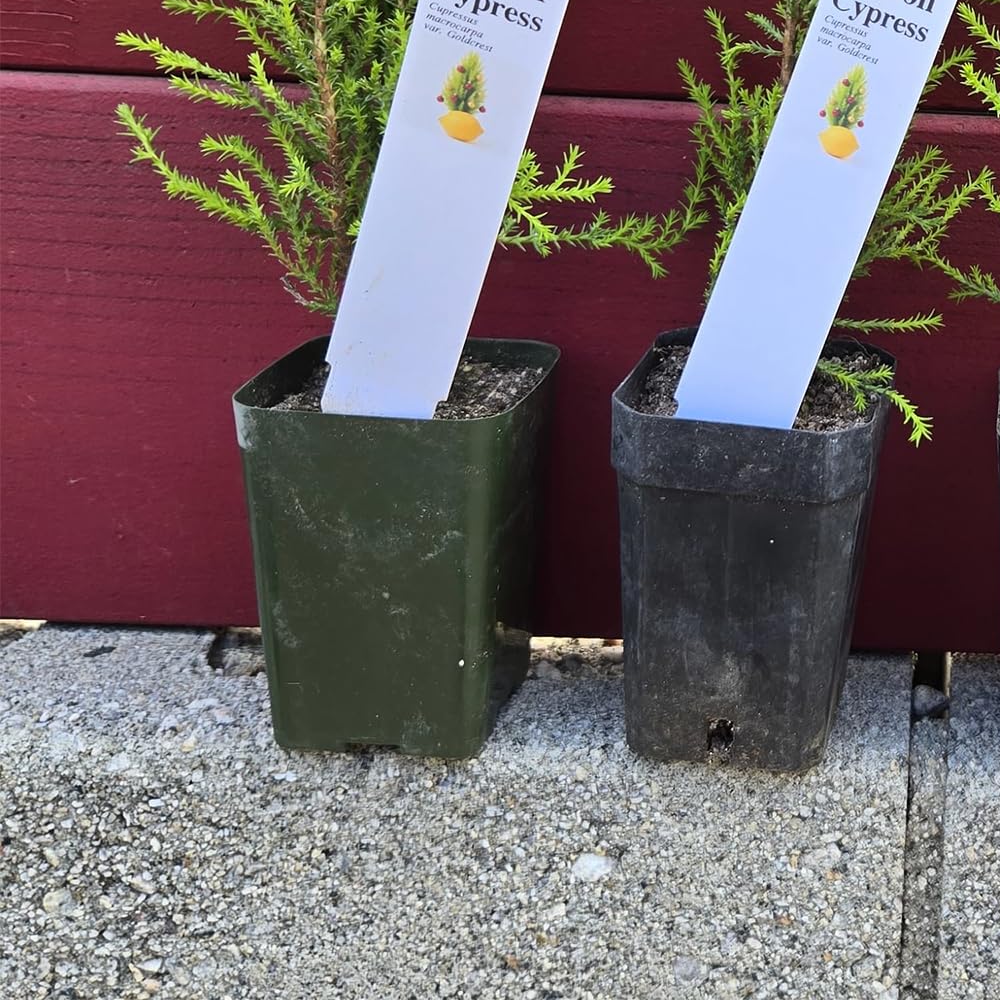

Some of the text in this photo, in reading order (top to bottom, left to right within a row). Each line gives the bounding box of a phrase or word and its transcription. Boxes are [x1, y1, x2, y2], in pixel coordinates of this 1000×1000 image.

[426, 13, 483, 38] macrocarpa
[429, 2, 478, 25] Cupressus
[424, 23, 493, 52] var. Goldcrest
[820, 26, 872, 50] macrocarpa
[825, 15, 868, 37] Cupressus
[817, 36, 879, 64] var. Goldcrest
